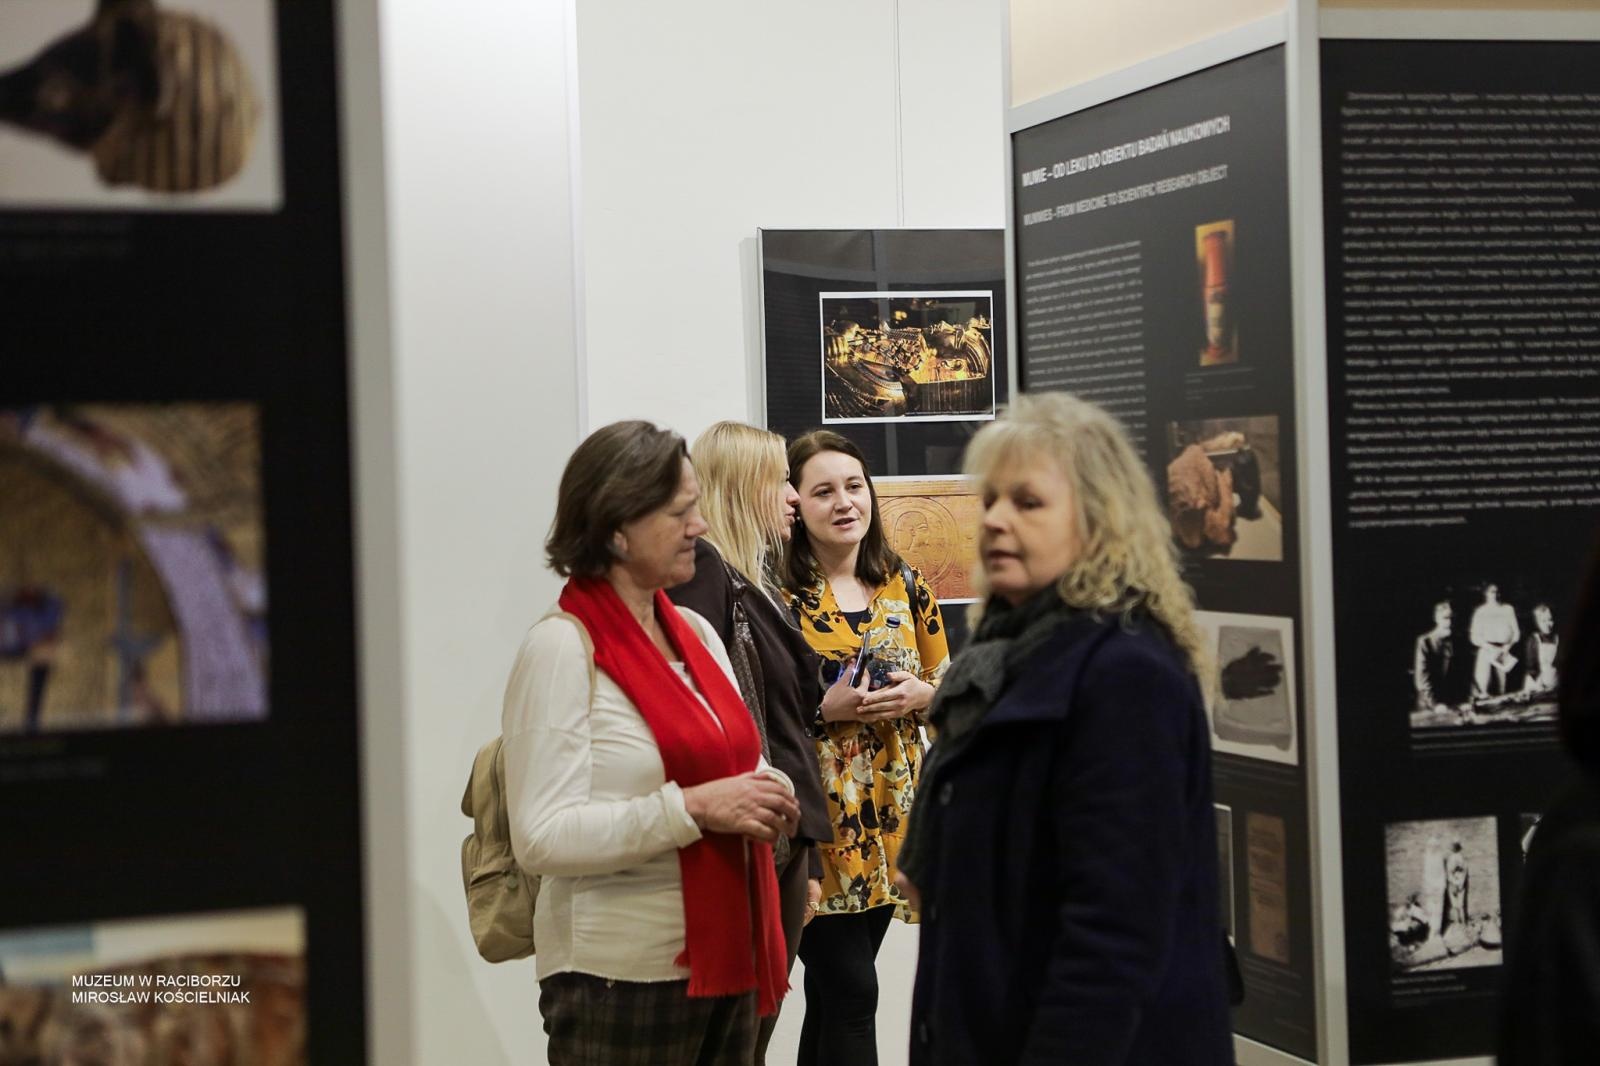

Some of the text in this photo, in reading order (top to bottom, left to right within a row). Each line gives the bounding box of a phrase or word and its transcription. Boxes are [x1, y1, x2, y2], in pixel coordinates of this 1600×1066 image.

[1053, 163, 1065, 179] OD
[1065, 157, 1087, 175] LEKU
[1088, 153, 1101, 170] DO
[1101, 142, 1137, 166] OBIEKTU
[1138, 129, 1170, 156] BADAŃ
[1169, 115, 1231, 147] NAUKOWYCH
[1056, 203, 1075, 218] FROM
[1107, 192, 1117, 206] TO
[1198, 164, 1229, 185] OBJECT
